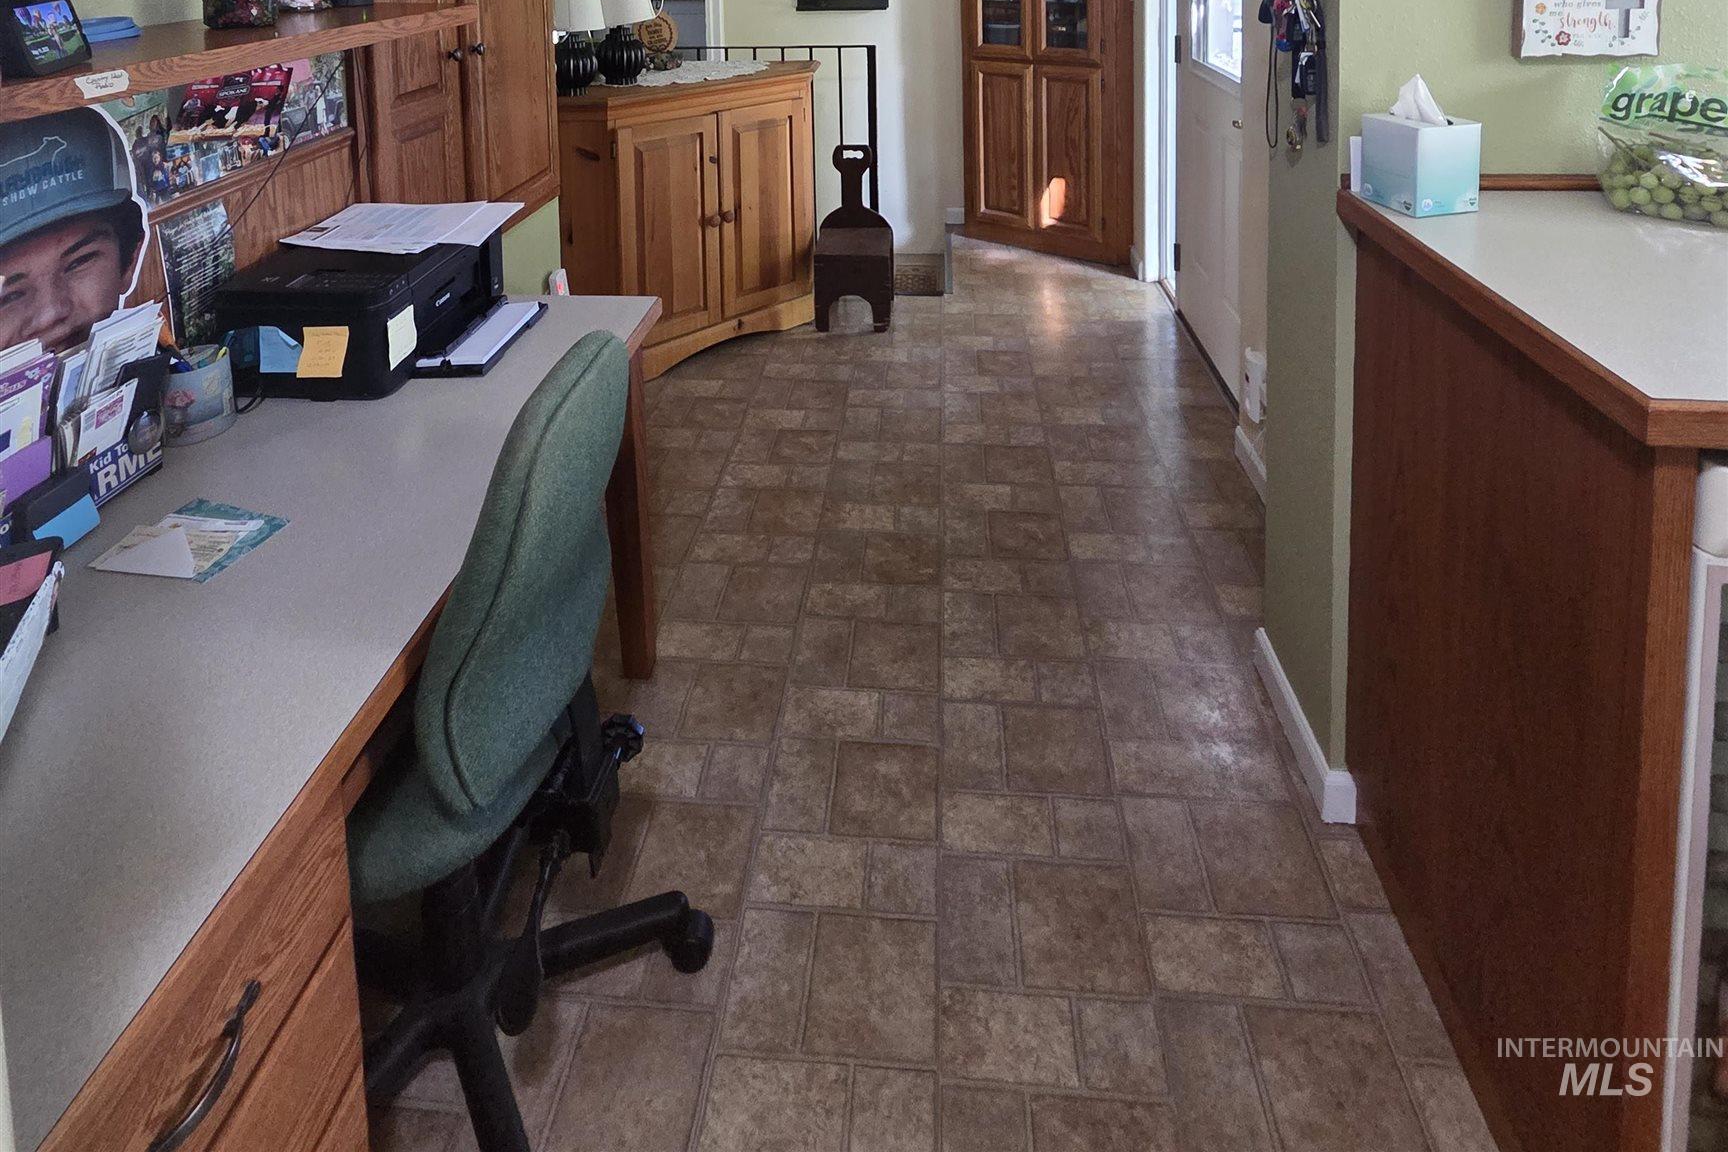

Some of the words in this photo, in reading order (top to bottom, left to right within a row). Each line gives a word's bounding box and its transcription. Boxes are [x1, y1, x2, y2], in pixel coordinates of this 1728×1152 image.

[1554, 0, 1573, 8] who
[1576, 0, 1602, 9] gives
[219, 87, 248, 98] SPOKANE
[1609, 90, 1728, 123] grape
[2, 184, 38, 207] SHOW
[42, 169, 84, 190] CATTLE
[89, 451, 112, 475] Kid
[94, 440, 162, 499] RME
